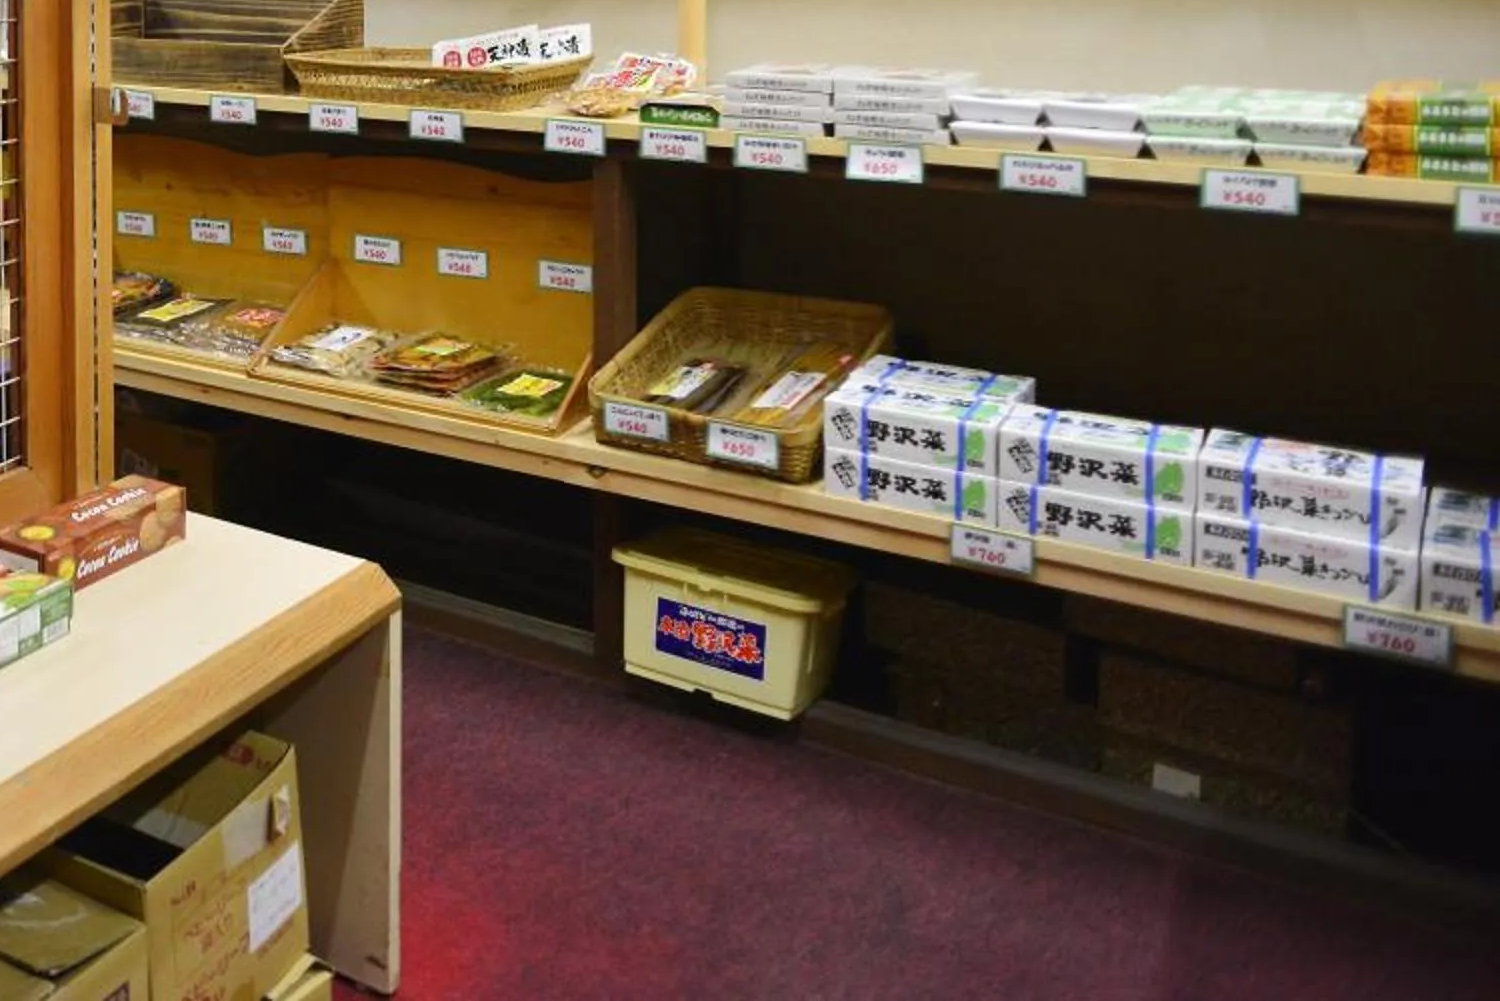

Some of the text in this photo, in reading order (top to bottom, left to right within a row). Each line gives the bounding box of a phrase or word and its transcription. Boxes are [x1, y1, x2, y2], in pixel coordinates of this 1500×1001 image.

[320, 116, 344, 128] ¥540
[557, 137, 586, 149] ¥540
[655, 143, 686, 156] ¥540
[751, 152, 783, 165] ¥540
[864, 162, 898, 175] ¥650
[1018, 172, 1059, 188] ¥540
[1222, 188, 1267, 205] ¥540
[617, 420, 648, 435] ¥540
[866, 419, 947, 453] 野沢菜
[722, 440, 756, 457] ¥650
[1046, 450, 1140, 487] 野沢菜
[866, 469, 948, 503] 野沢菜
[1044, 502, 1137, 539] 野沢菜
[967, 546, 1006, 566] ¥760
[1366, 629, 1417, 654] ¥760
